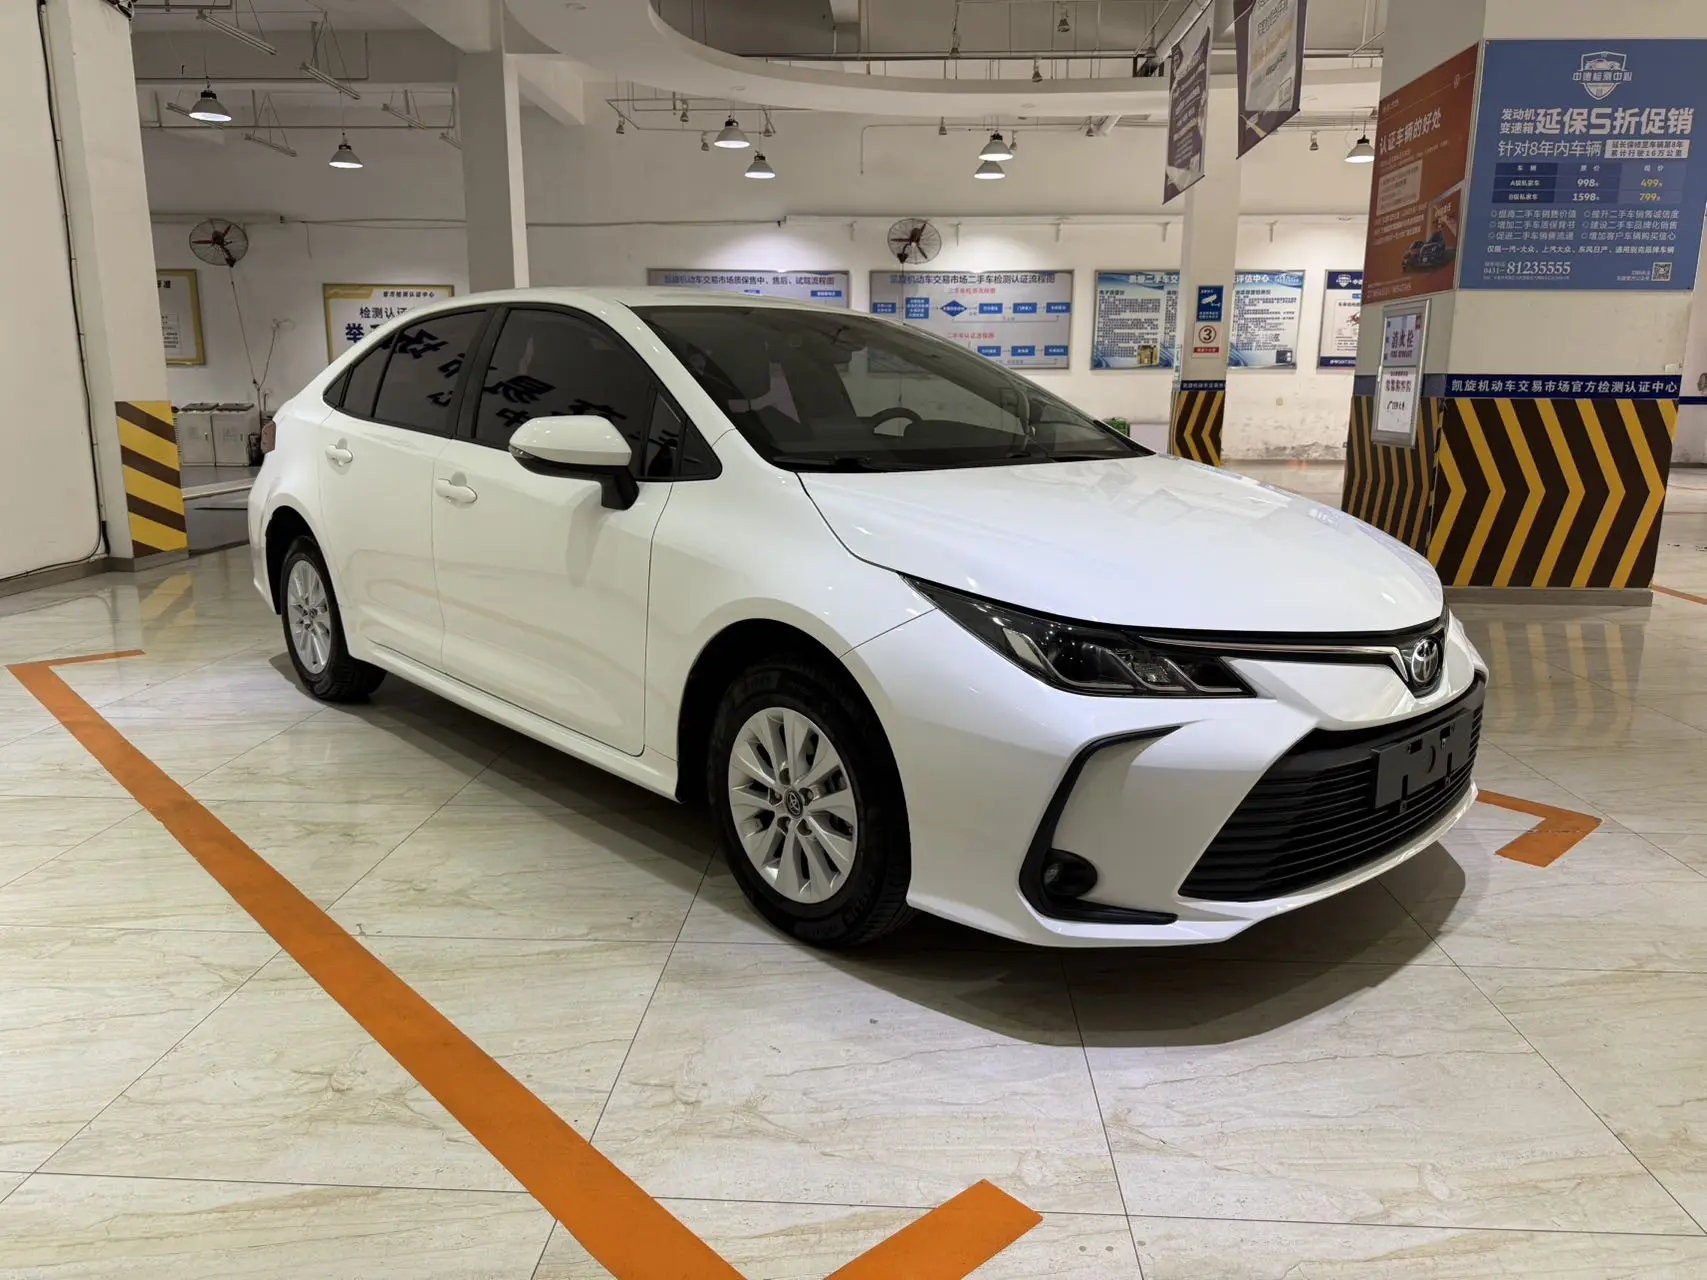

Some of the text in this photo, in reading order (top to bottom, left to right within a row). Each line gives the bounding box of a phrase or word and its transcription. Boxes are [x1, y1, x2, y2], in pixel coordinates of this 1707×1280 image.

[1502, 108, 1535, 121] 发动机
[1535, 107, 1695, 135] 延保5折促销
[1379, 107, 1442, 155] 认证车辆的好处
[1500, 122, 1534, 134] 变速箱
[1498, 140, 1602, 157] 针对8年内车辆
[1203, 328, 1212, 341] 3
[1451, 379, 1678, 392] 凯旋机动车交易市场官方检测认证中心
